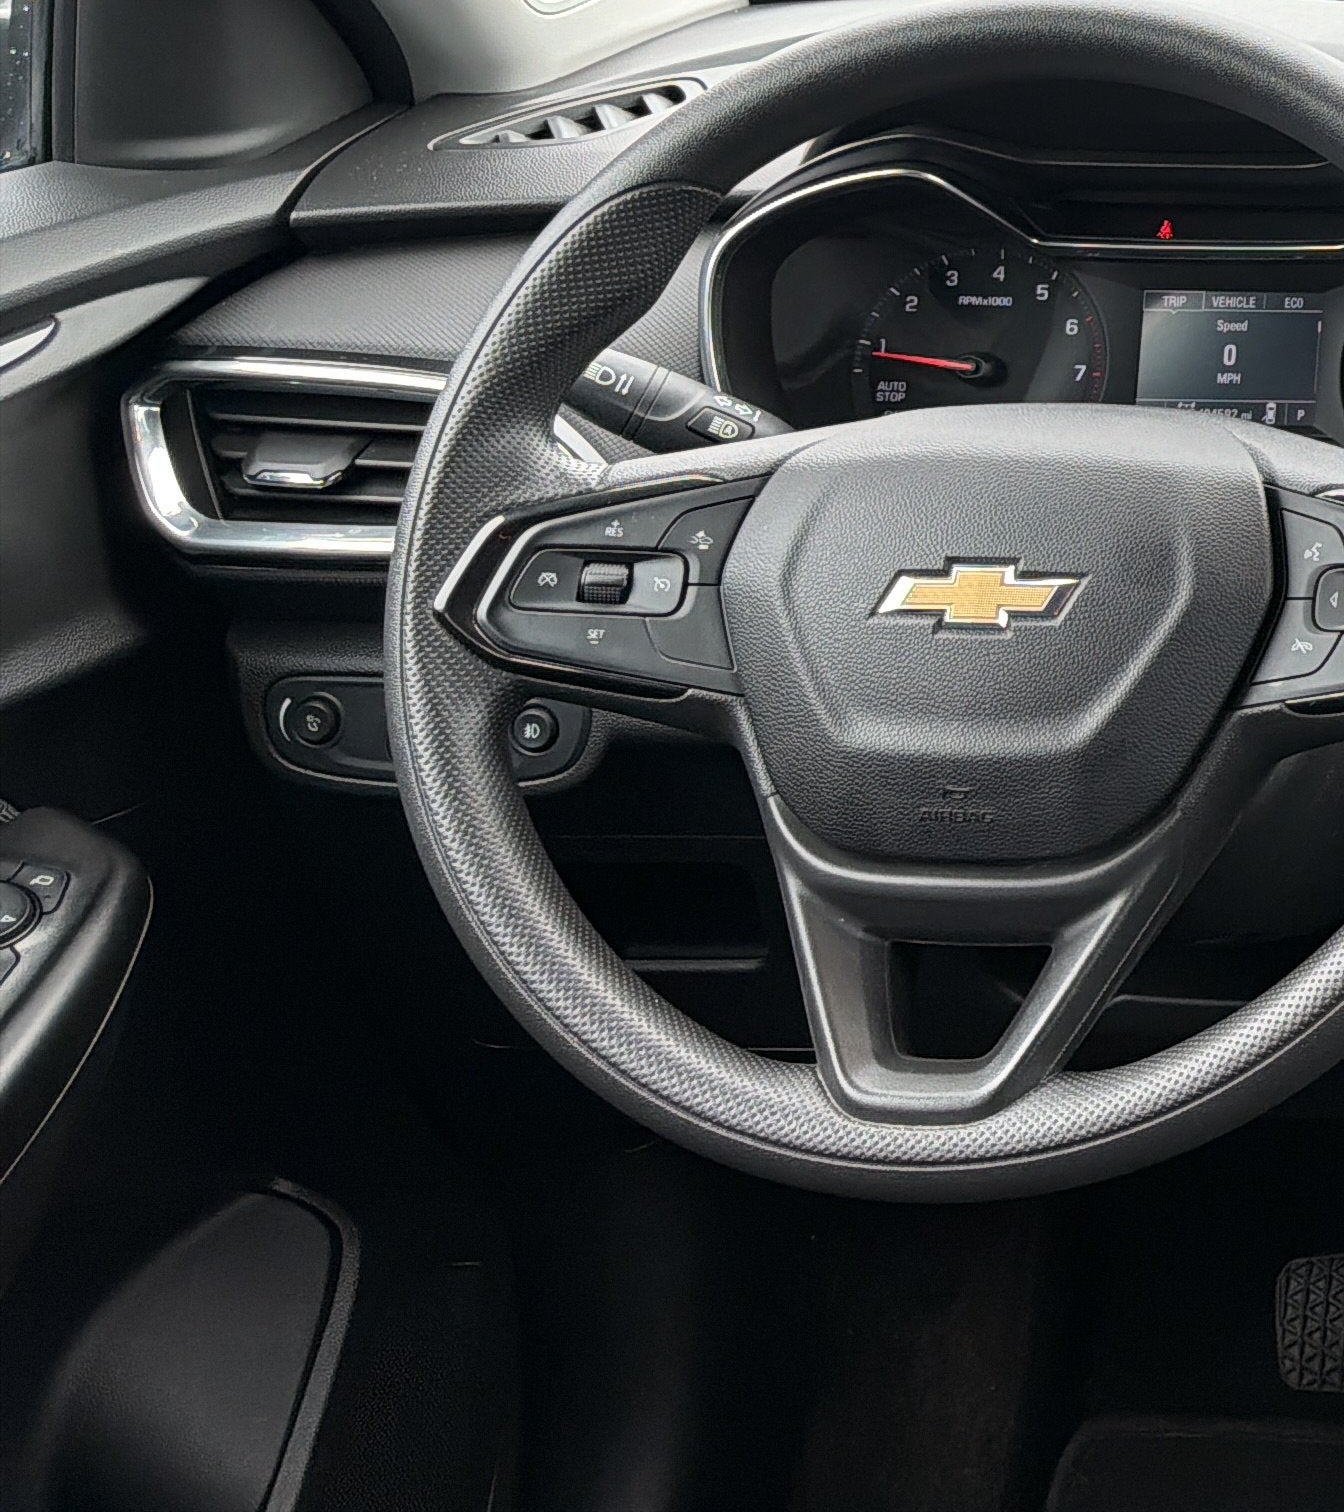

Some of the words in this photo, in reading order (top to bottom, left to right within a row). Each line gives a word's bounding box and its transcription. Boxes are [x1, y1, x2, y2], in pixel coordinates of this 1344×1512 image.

[945, 270, 958, 286] 3
[993, 265, 1006, 282] 4
[1036, 284, 1049, 301] 5
[904, 296, 918, 312] 2
[1162, 295, 1187, 308] TRIP
[1212, 296, 1257, 308] VEHICLE
[1284, 297, 1304, 309] ECO
[1065, 318, 1079, 336] 6
[1216, 319, 1248, 334] Speed
[1223, 343, 1237, 366] 0
[1074, 365, 1087, 381] 7
[1217, 372, 1241, 384] MPH
[877, 380, 906, 391] AUTO
[876, 391, 905, 402] STOP
[1296, 409, 1305, 421] P
[605, 526, 624, 538] RES
[586, 627, 605, 640] SET
